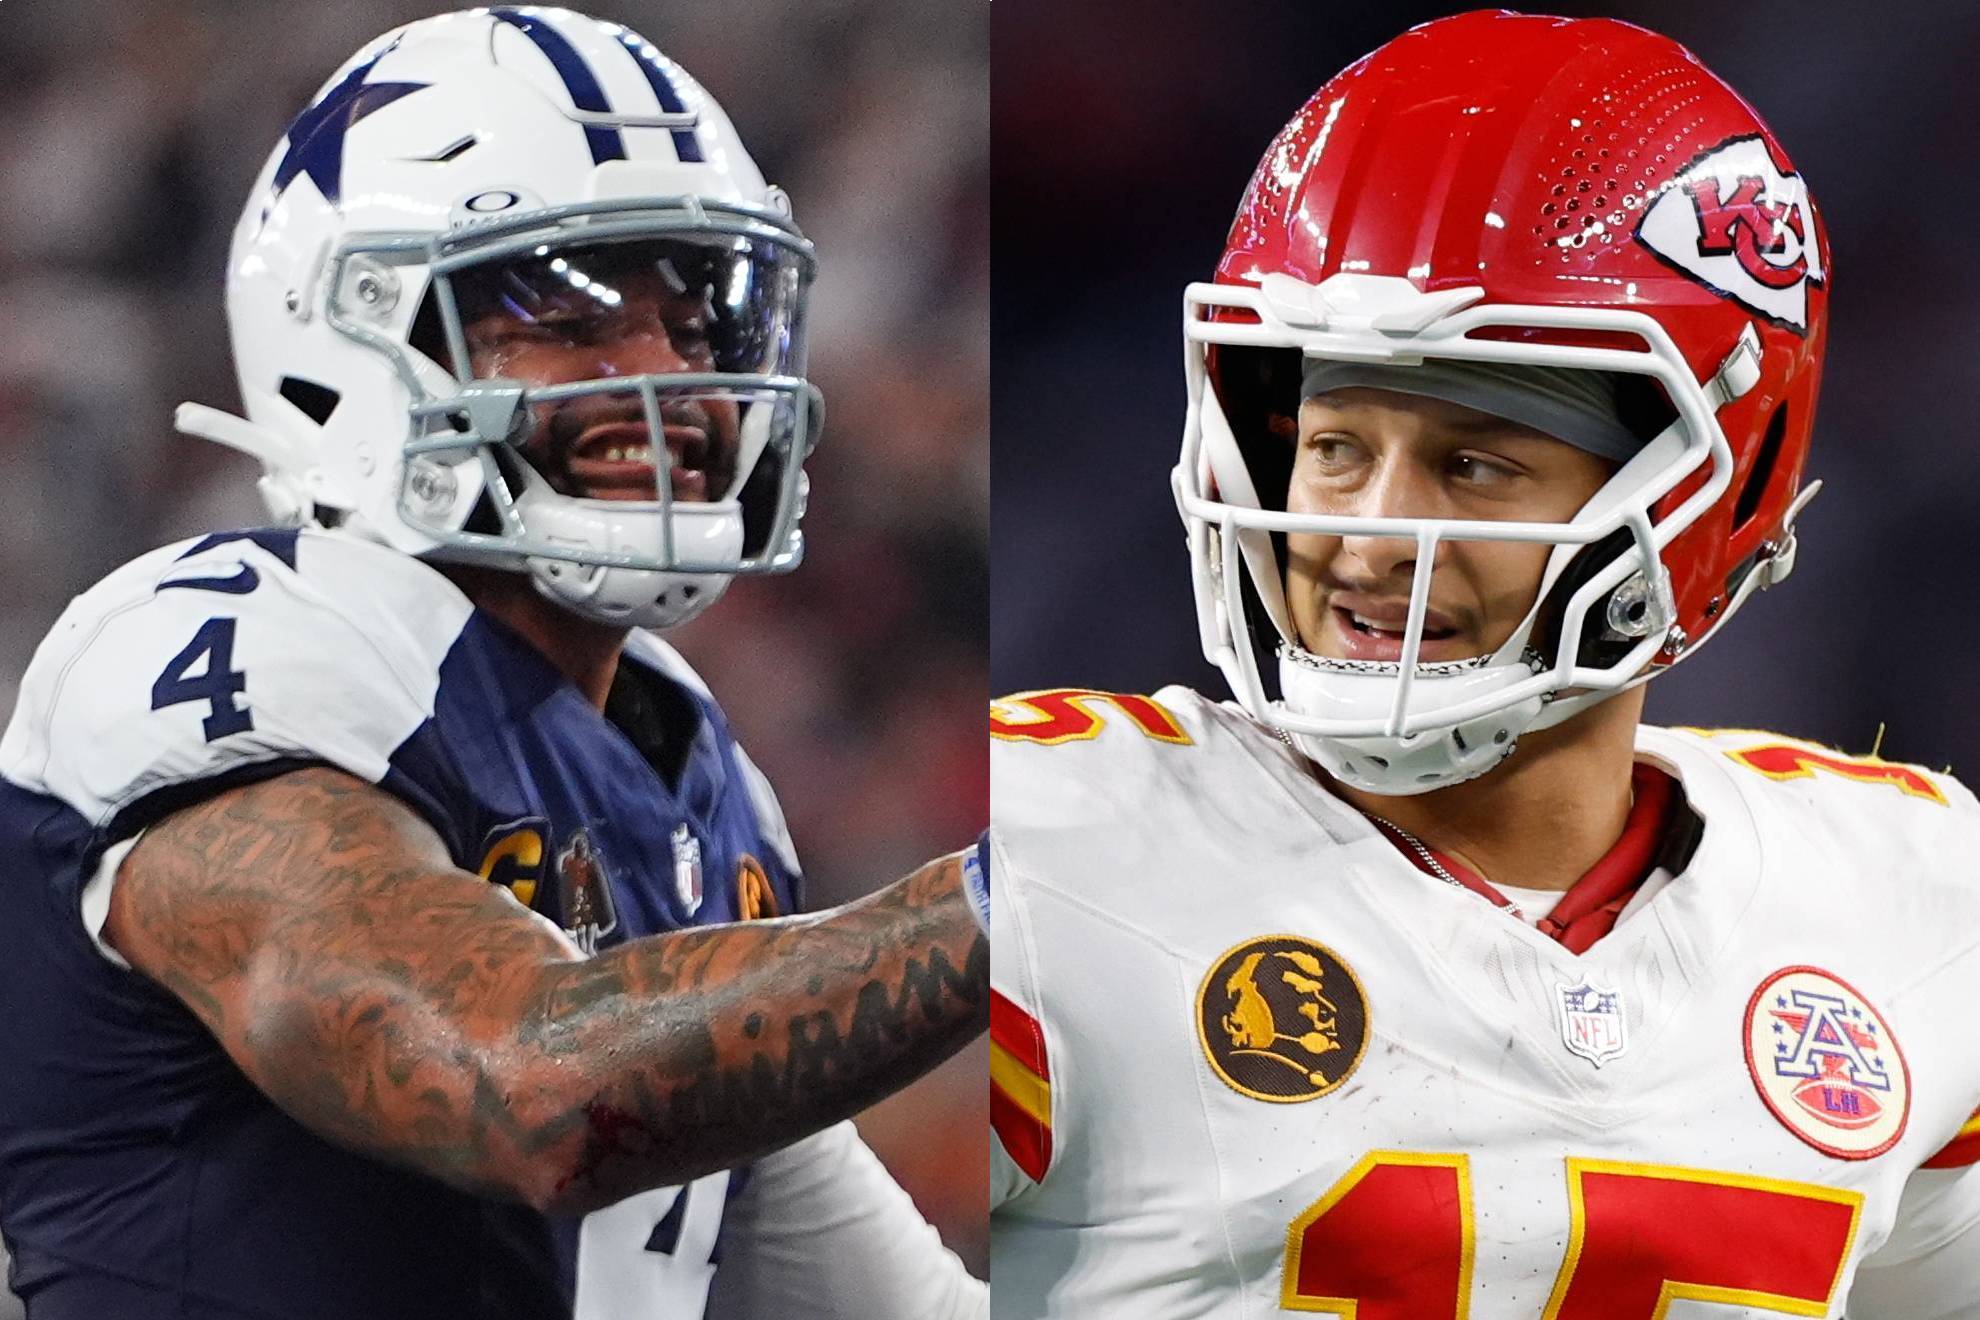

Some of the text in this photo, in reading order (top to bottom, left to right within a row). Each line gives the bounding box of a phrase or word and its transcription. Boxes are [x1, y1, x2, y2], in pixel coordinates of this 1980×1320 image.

[1682, 175, 1809, 290] KC
[151, 616, 255, 743] 4
[1571, 1014, 1619, 1050] NFL
[1773, 989, 1892, 1092] A
